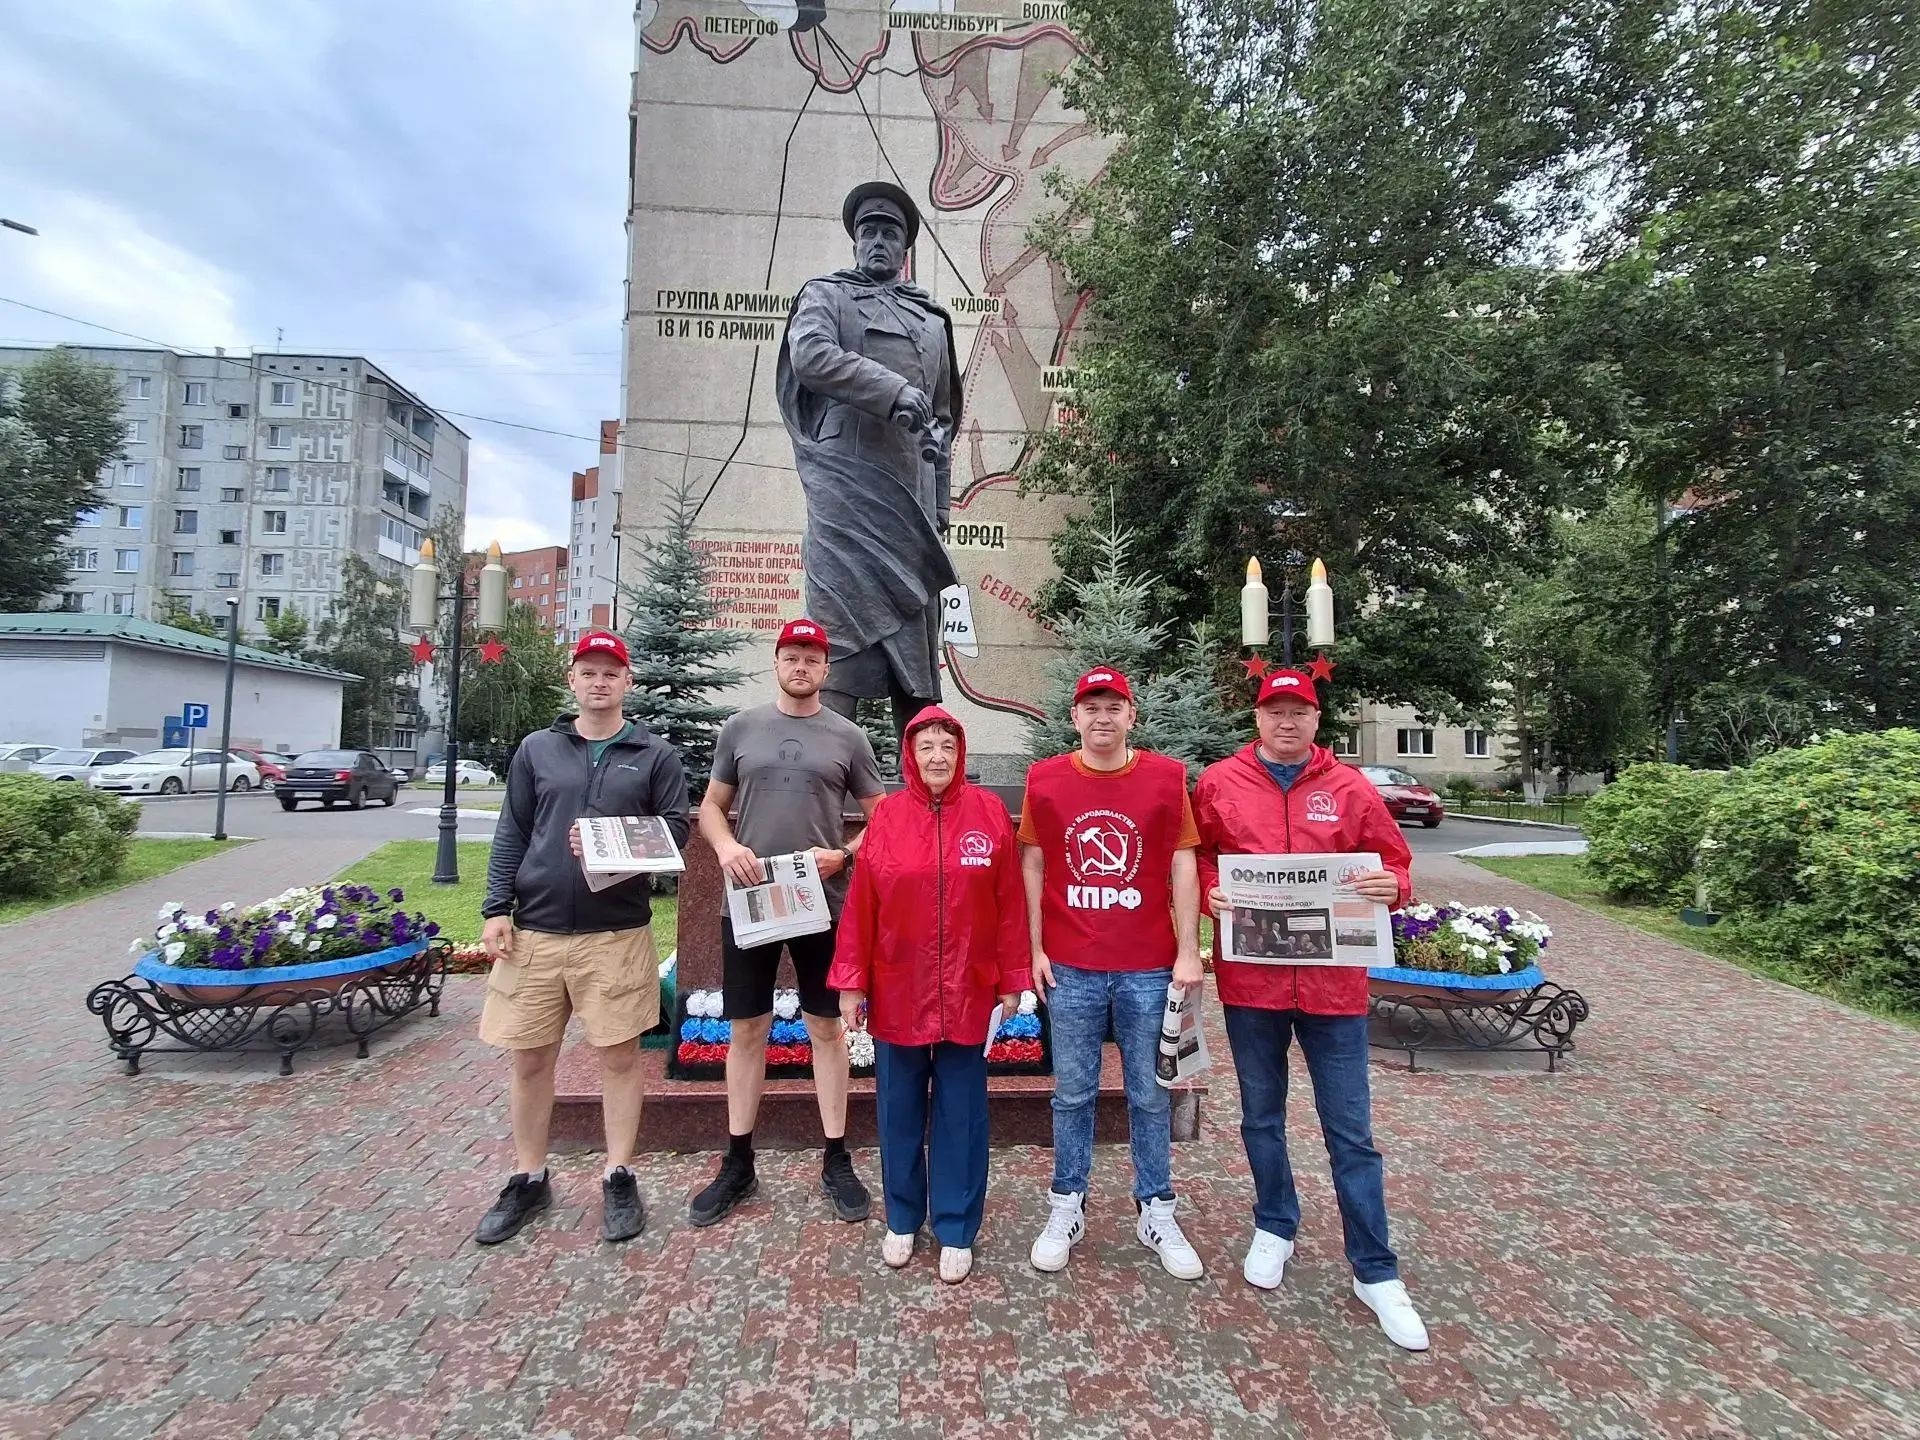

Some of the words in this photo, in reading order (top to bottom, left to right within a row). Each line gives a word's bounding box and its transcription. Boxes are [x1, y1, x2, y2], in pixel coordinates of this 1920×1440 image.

[704, 16, 778, 36] ПЕТЕРГОФ
[888, 12, 1000, 33] ШЛИССЕЛЬБУРГ
[657, 290, 719, 310] ГРУППА
[951, 297, 999, 313] ЧУДОВО
[656, 318, 674, 337] 18
[679, 319, 689, 337] И
[696, 320, 714, 339] 16
[718, 321, 775, 341] АРМИИ
[942, 524, 1004, 548] ГОРОД
[735, 541, 800, 555] ЛЕНИНГРАДА
[189, 706, 205, 725] P
[1306, 812, 1339, 822] КПРФ
[960, 856, 992, 867] КПРФ
[1266, 869, 1328, 885] ПРАВДА
[1067, 884, 1142, 910] КПРФ
